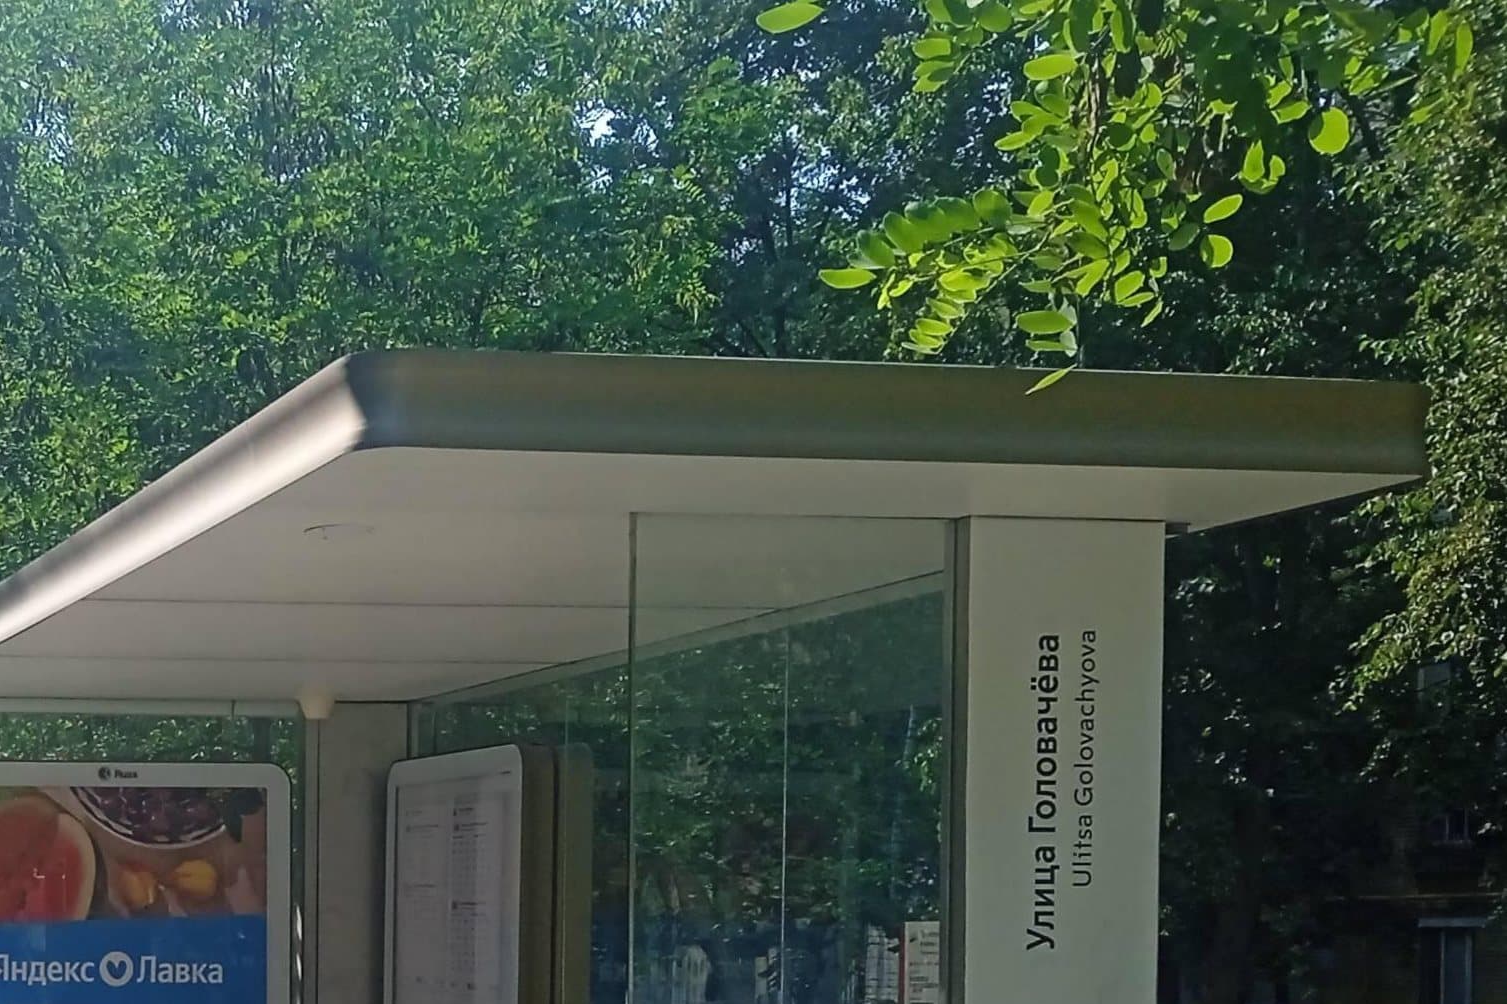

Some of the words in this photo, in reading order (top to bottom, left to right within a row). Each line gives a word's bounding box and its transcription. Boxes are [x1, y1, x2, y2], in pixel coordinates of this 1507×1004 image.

[1028, 634, 1060, 833] Головачёва
[1073, 630, 1100, 806] Golovachyova
[1026, 845, 1060, 951] Улица
[1072, 814, 1093, 887] Ulitsa
[137, 956, 224, 984] Лавка
